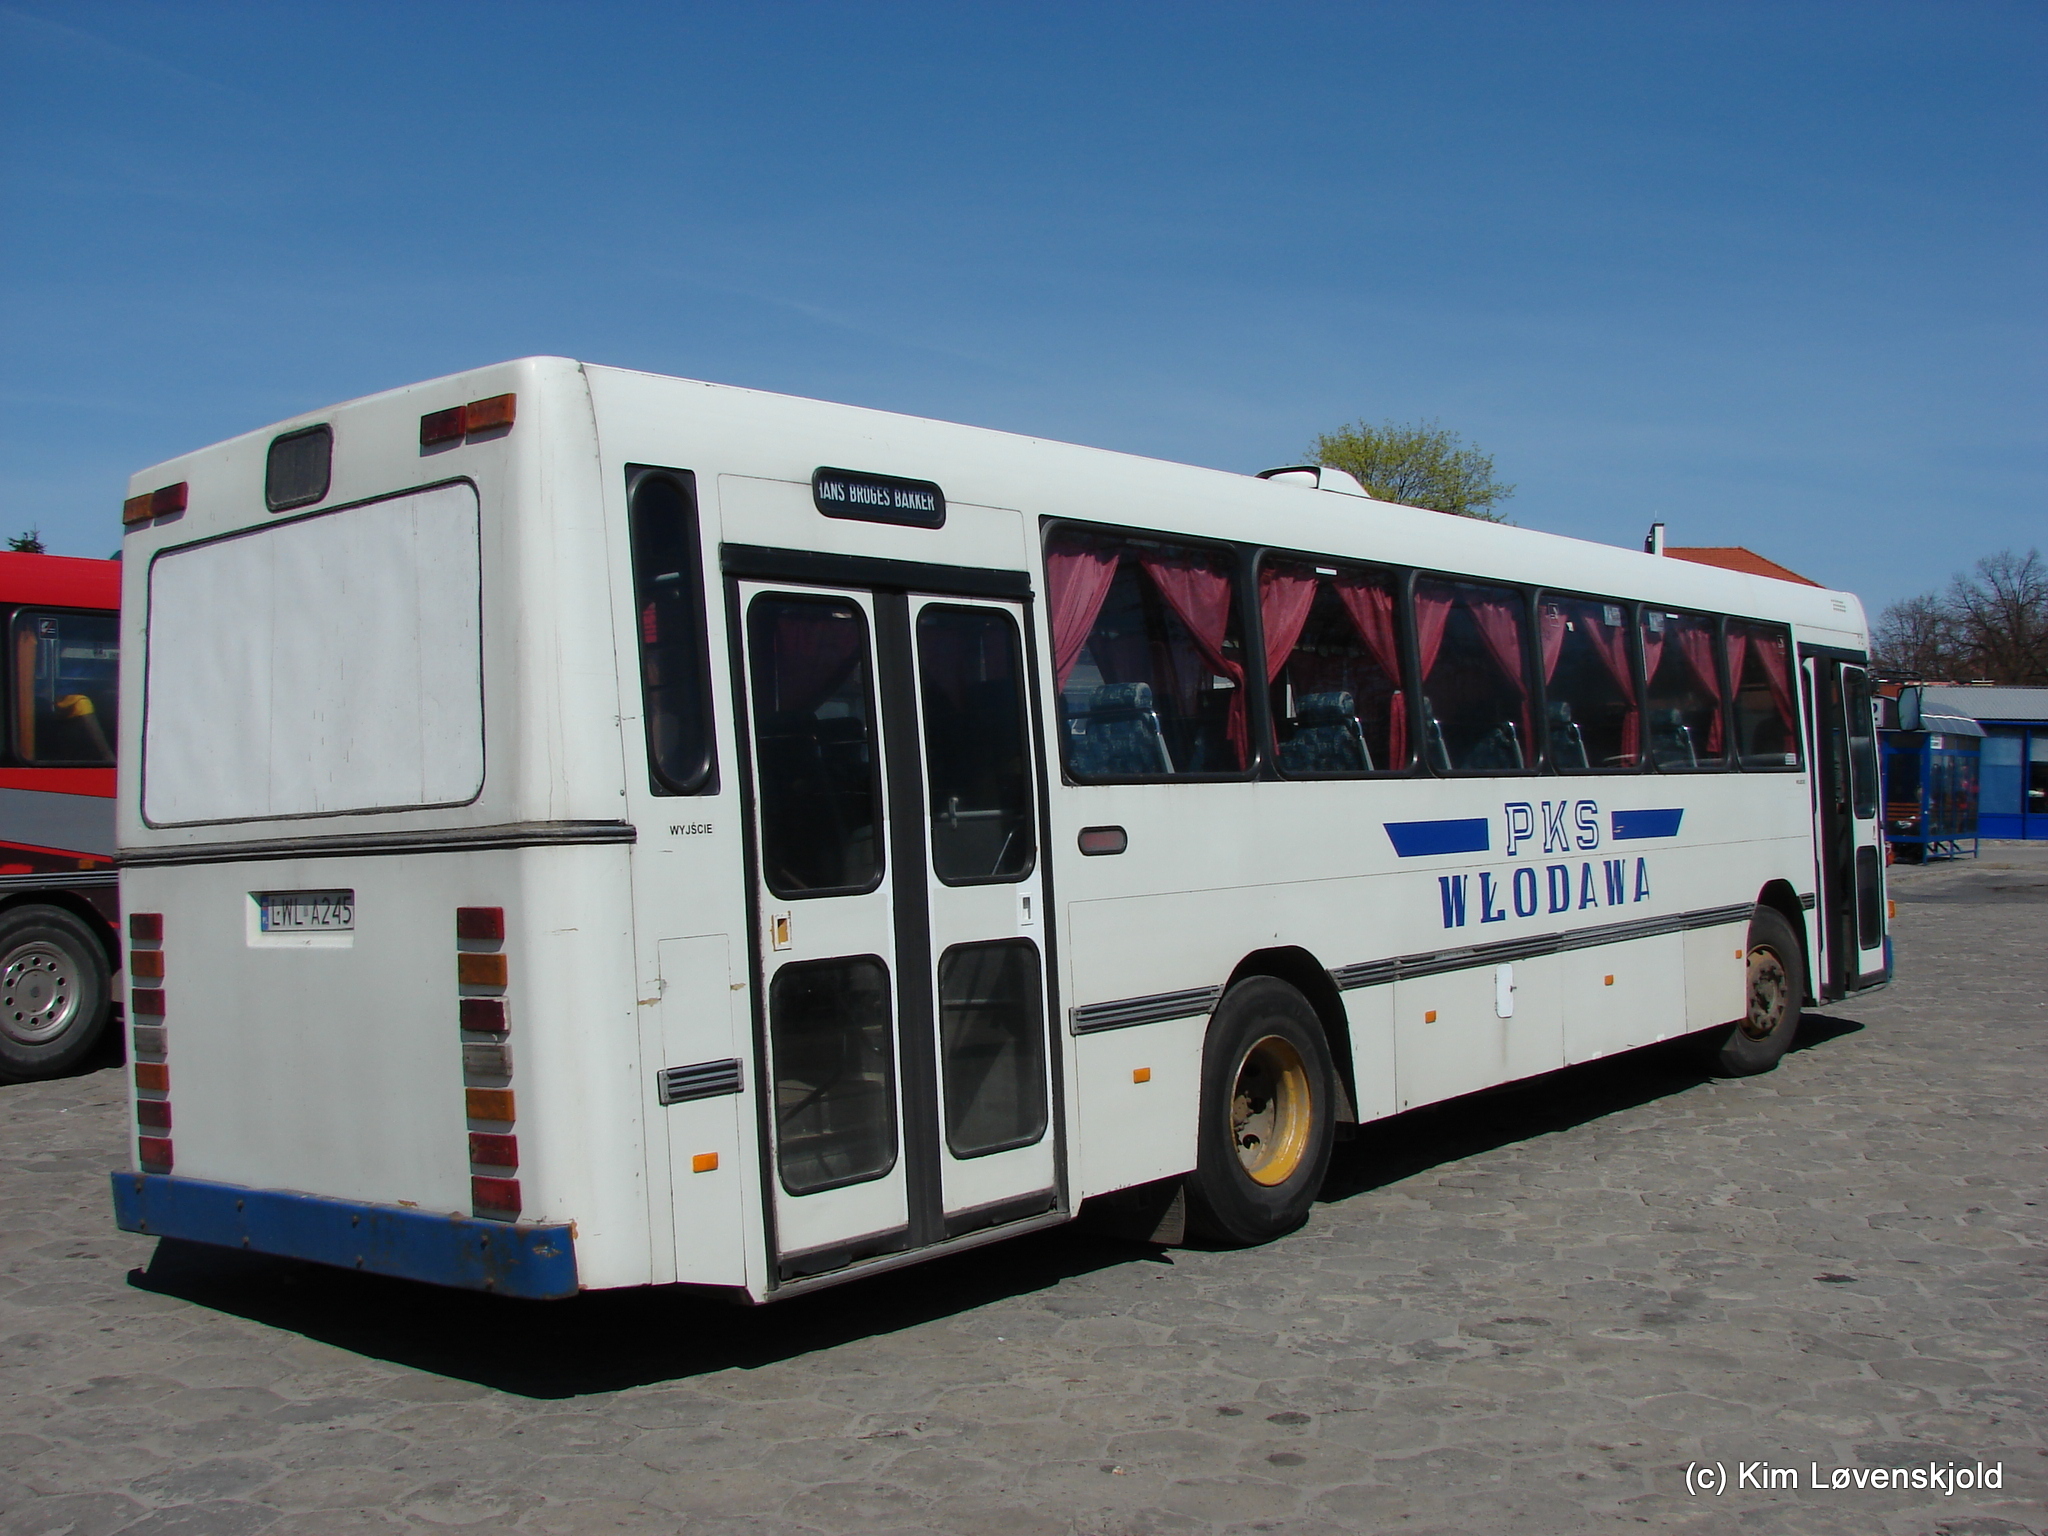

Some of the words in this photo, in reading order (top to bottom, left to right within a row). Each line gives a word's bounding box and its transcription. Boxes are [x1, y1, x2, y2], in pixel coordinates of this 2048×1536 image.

[894, 488, 935, 511] BAKKER
[669, 821, 713, 835] WYJŚCIE
[1505, 800, 1599, 856] PKS
[1438, 856, 1651, 929] WŁODAWA
[311, 895, 351, 925] A245
